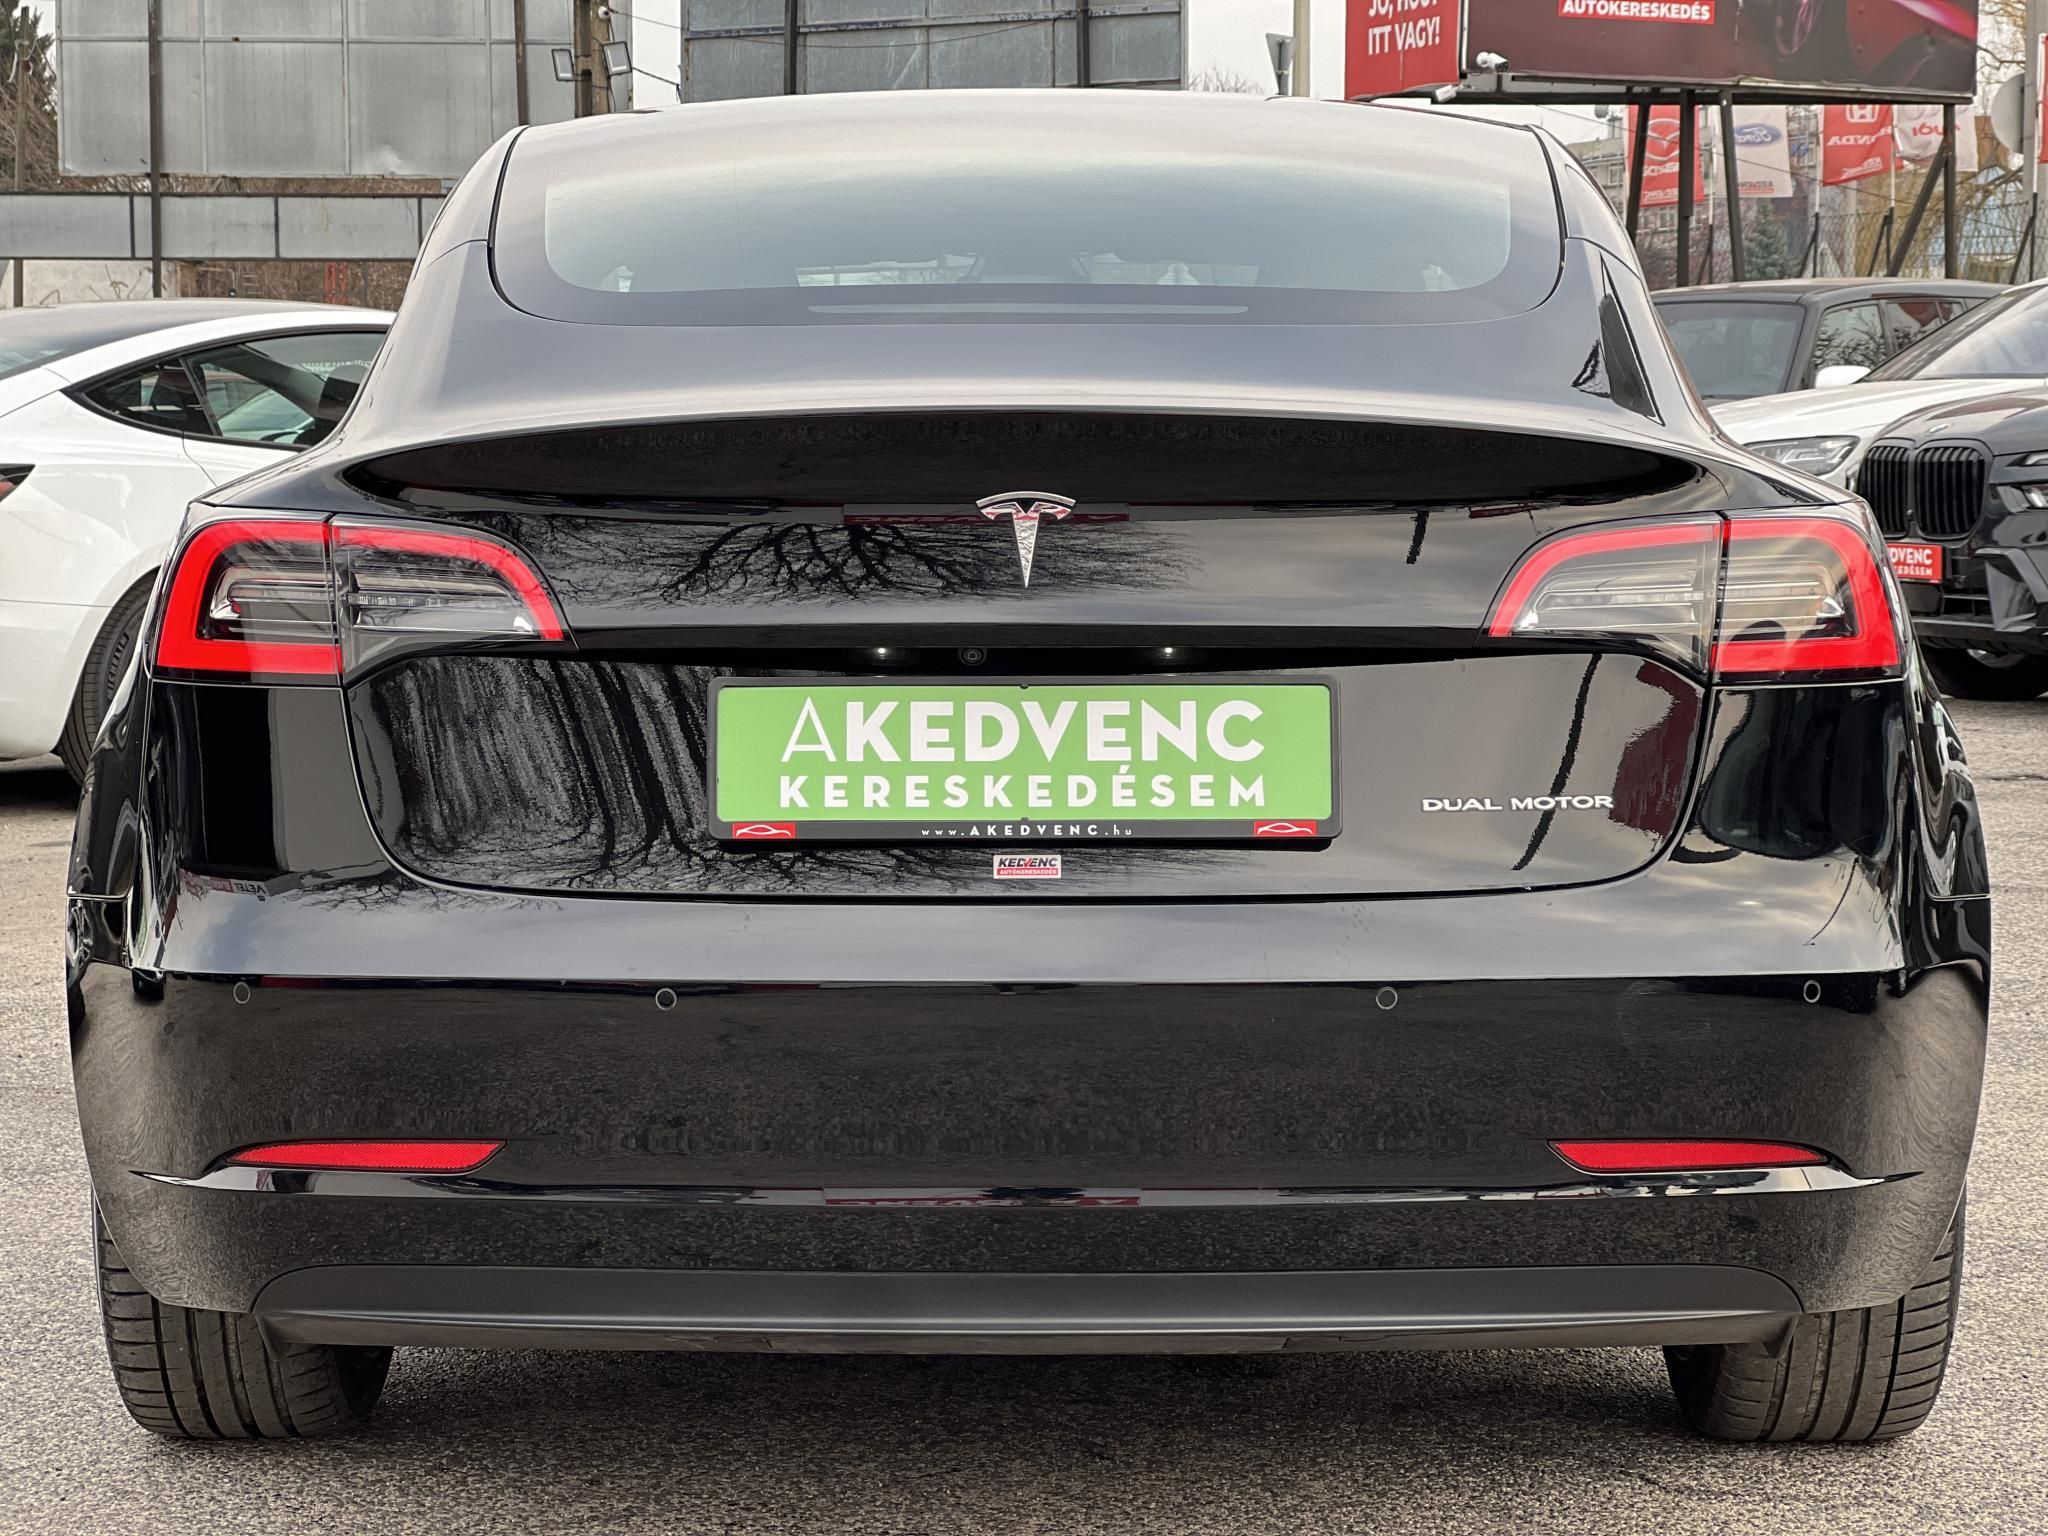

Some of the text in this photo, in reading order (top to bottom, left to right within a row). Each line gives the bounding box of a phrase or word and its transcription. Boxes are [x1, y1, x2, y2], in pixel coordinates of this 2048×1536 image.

[1368, 16, 1440, 55] ITT VAGY!
[780, 765, 1265, 808] KERESKEDÉSEM
[1421, 795, 1614, 812] DUAL MOTOR
[921, 824, 1132, 837] www.AKEDVENC.hu
[998, 856, 1059, 868] KEDVENC
